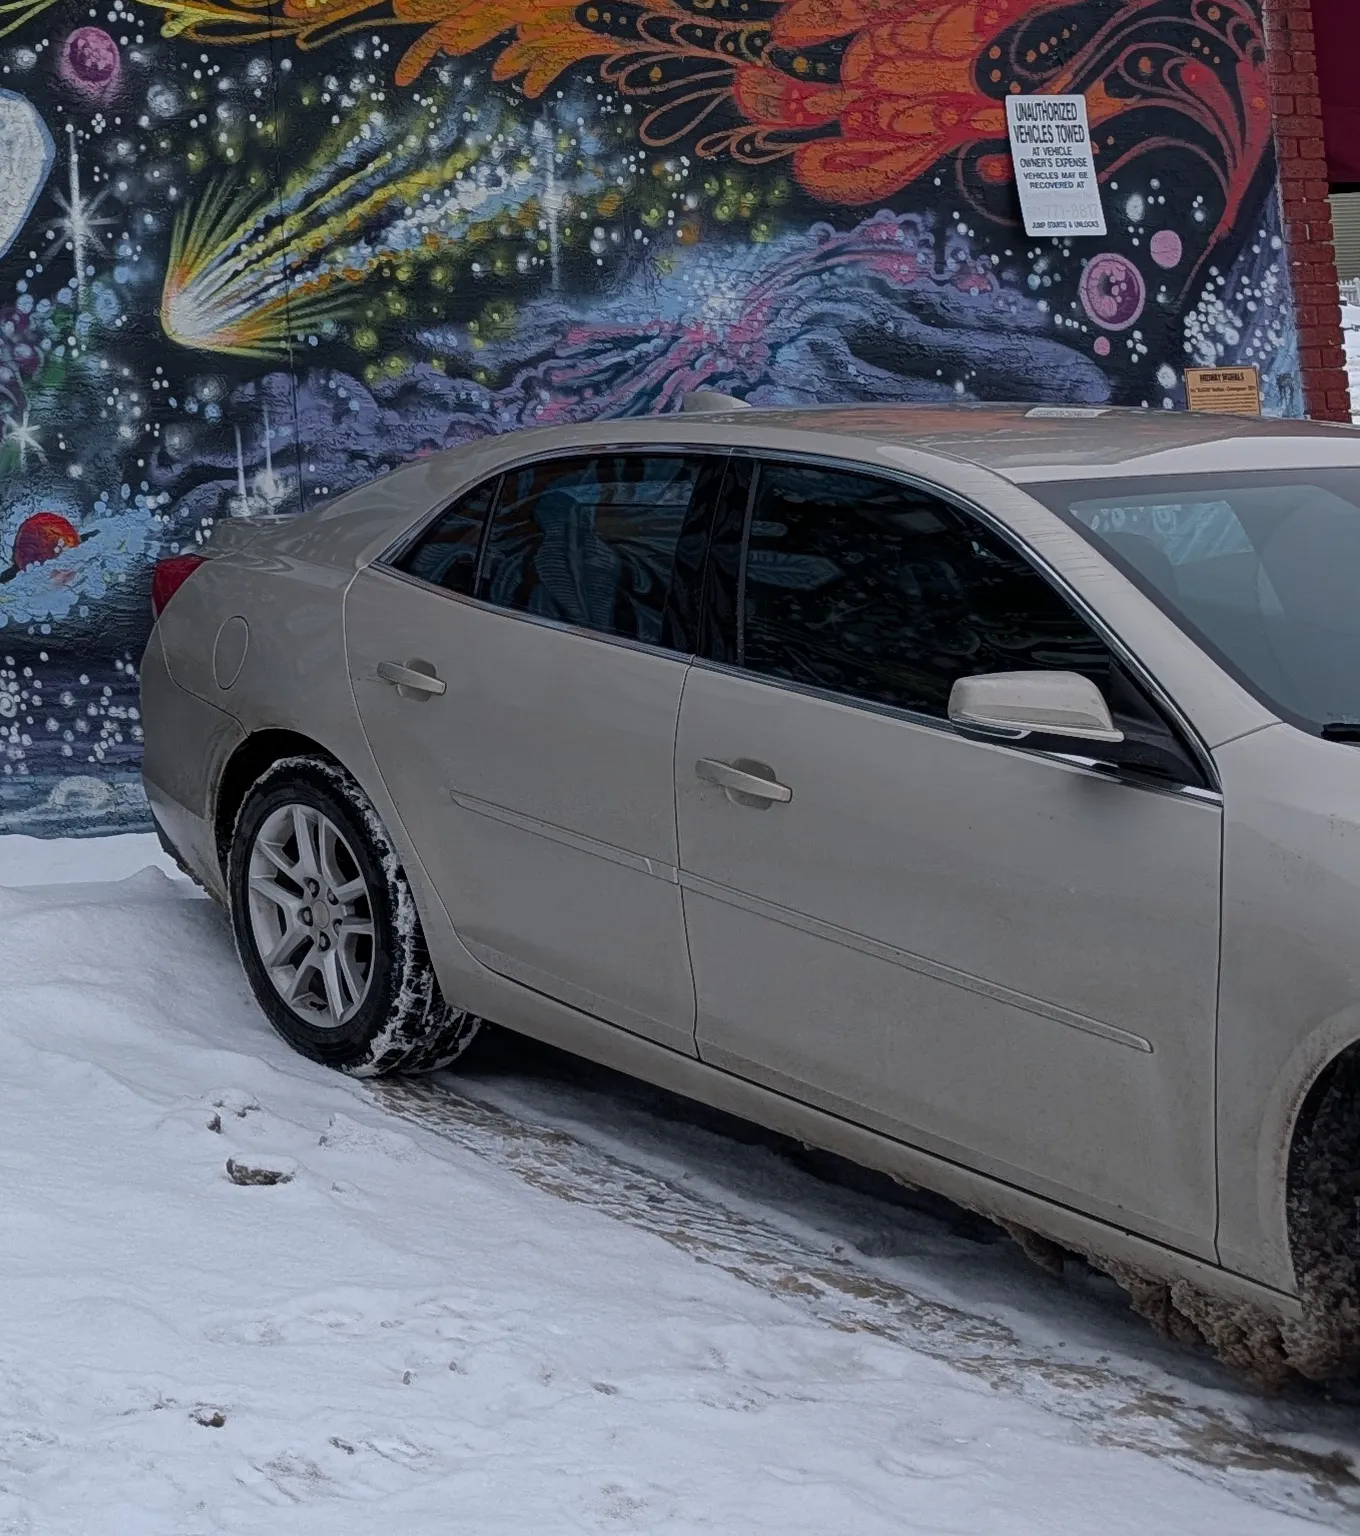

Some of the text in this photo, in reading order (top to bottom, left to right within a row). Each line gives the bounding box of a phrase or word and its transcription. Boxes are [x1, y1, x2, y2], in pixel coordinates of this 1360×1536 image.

[1014, 102, 1078, 122] UNAUTHORIZED
[1013, 124, 1086, 144] VEHICLES TOWED
[1032, 146, 1073, 156] AT VEHICLE
[1019, 157, 1088, 168] OWNER'S EXPENSE
[1023, 171, 1089, 180] VEHICLES MAY BE
[1029, 180, 1085, 189] RECOVERED AT
[1032, 221, 1046, 229] JUMP
[1047, 221, 1067, 229] STARTS
[1074, 220, 1100, 228] UNLOCKS
